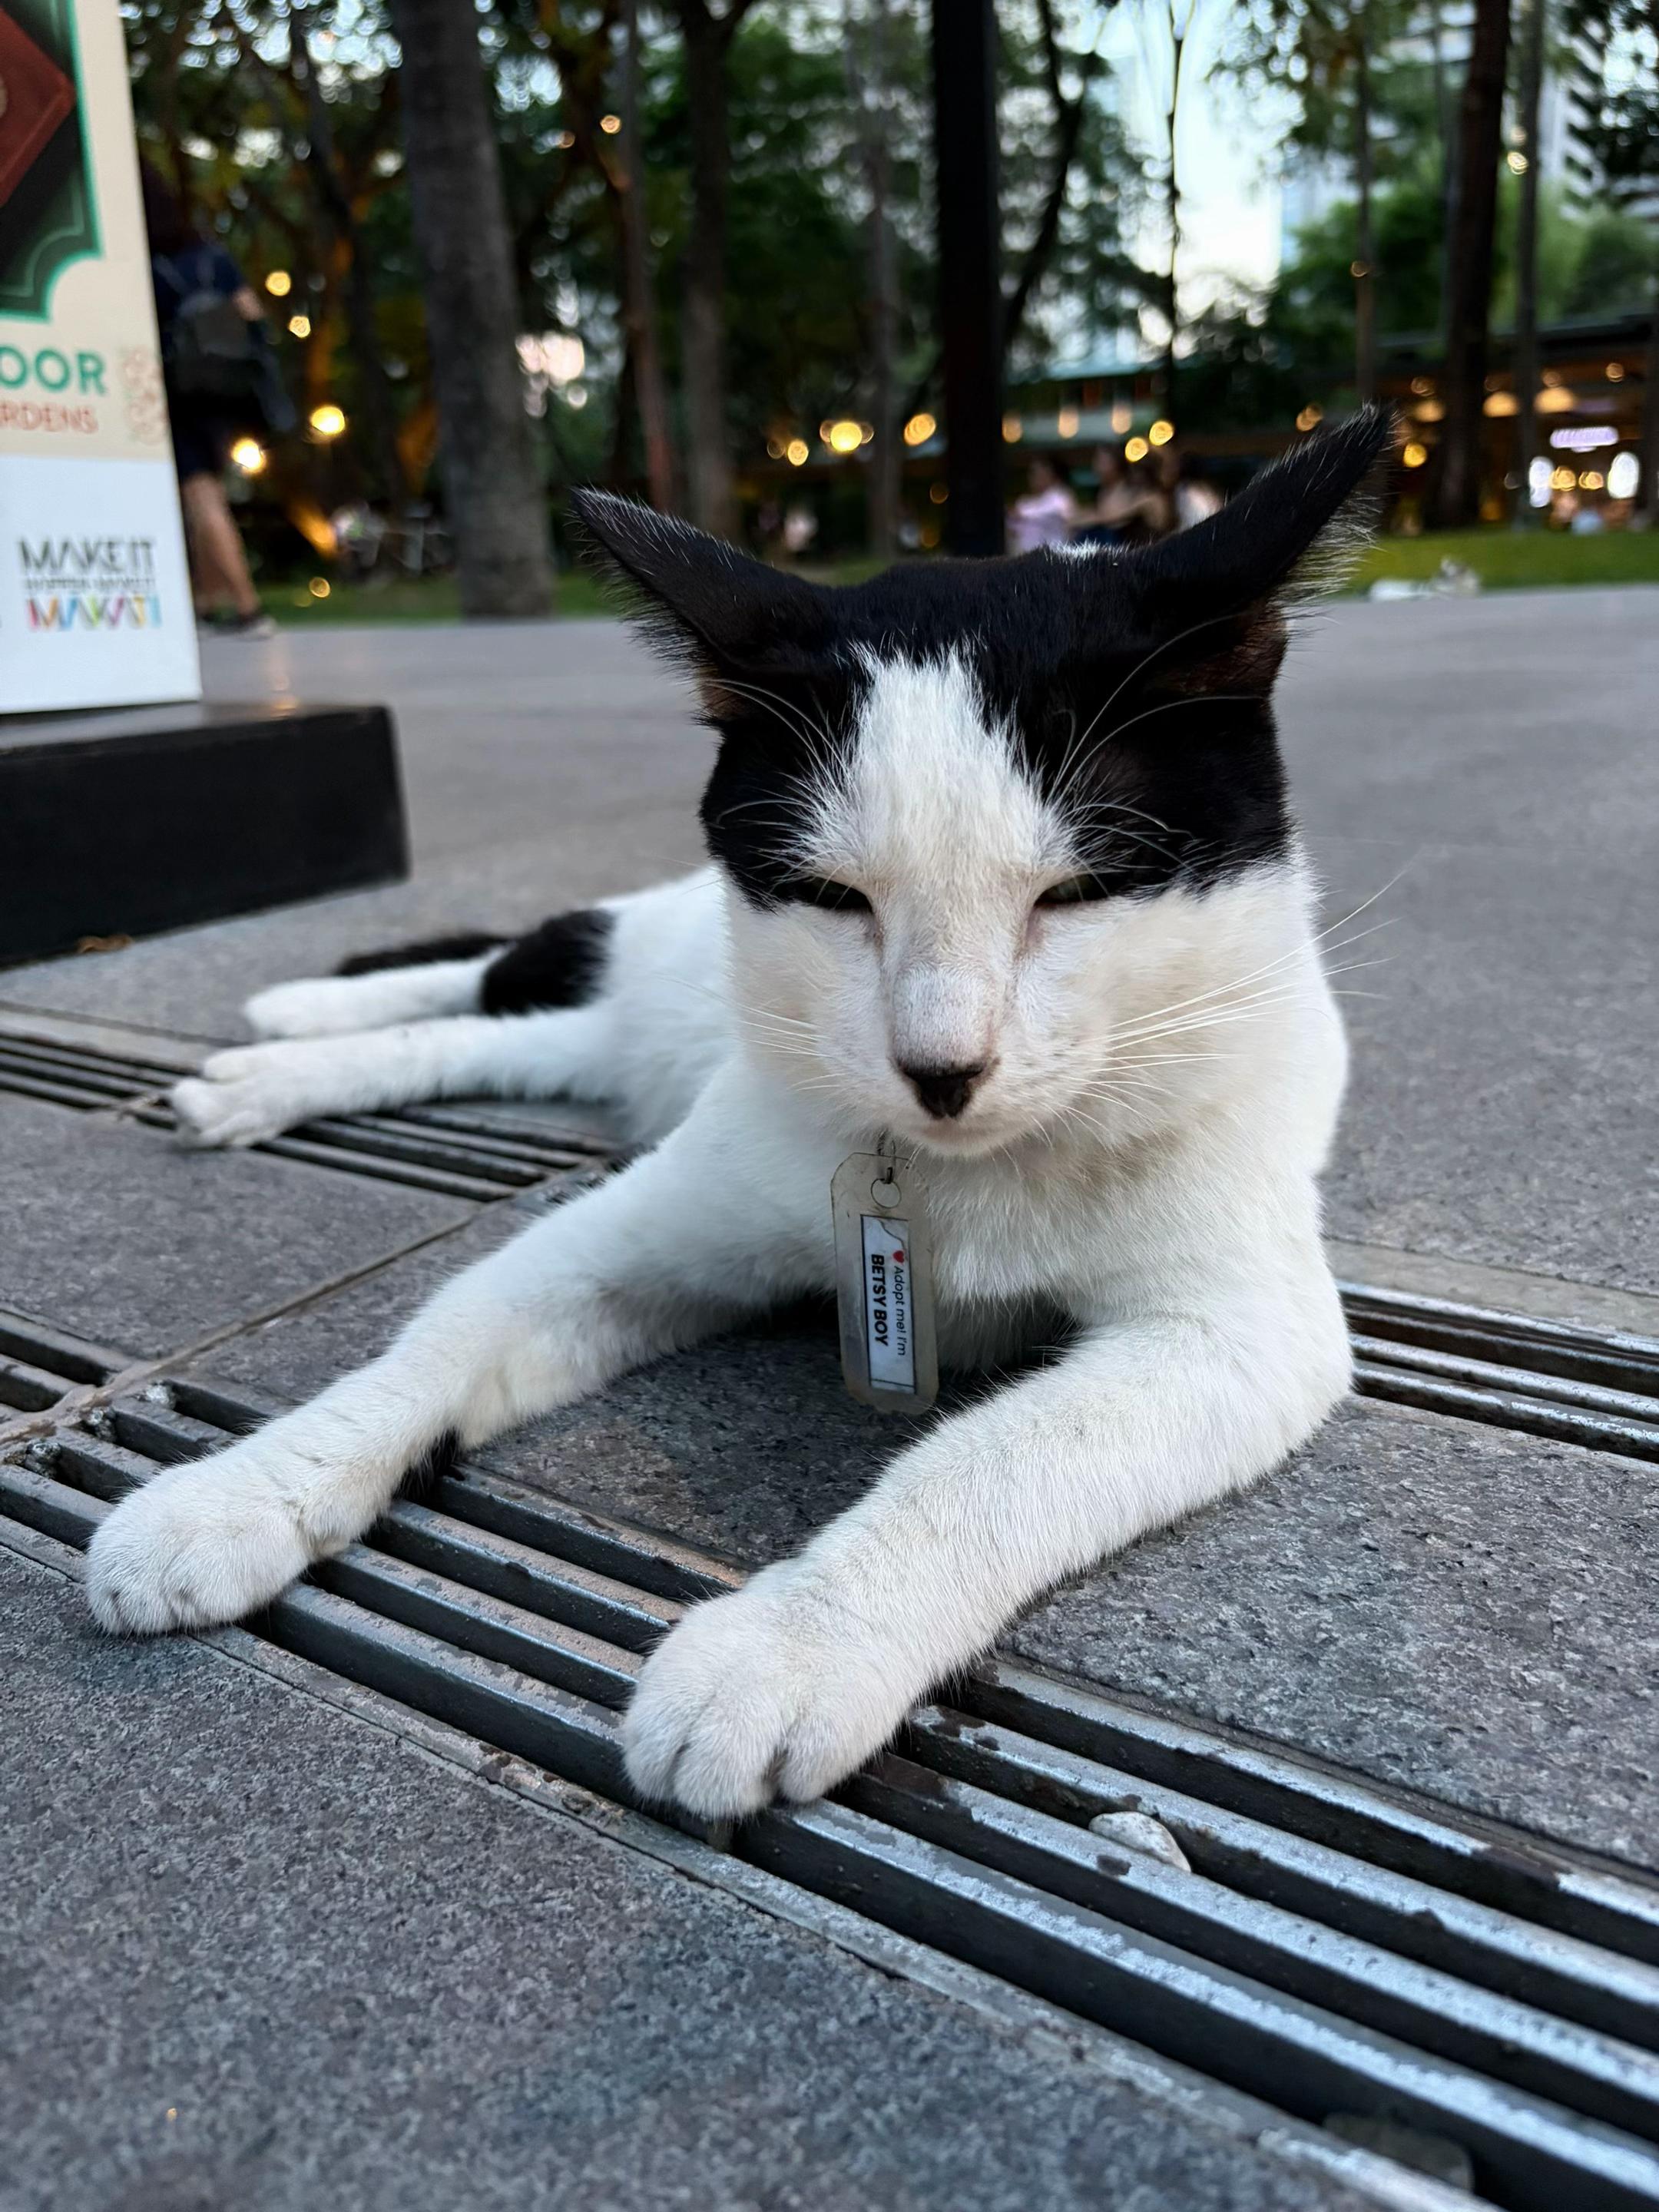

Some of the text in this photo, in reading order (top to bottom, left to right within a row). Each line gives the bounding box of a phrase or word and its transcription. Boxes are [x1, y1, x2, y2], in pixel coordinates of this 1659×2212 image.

[871, 1253, 889, 1347] BETSY BOY
[892, 1266, 908, 1356] Adopt me! I'm
